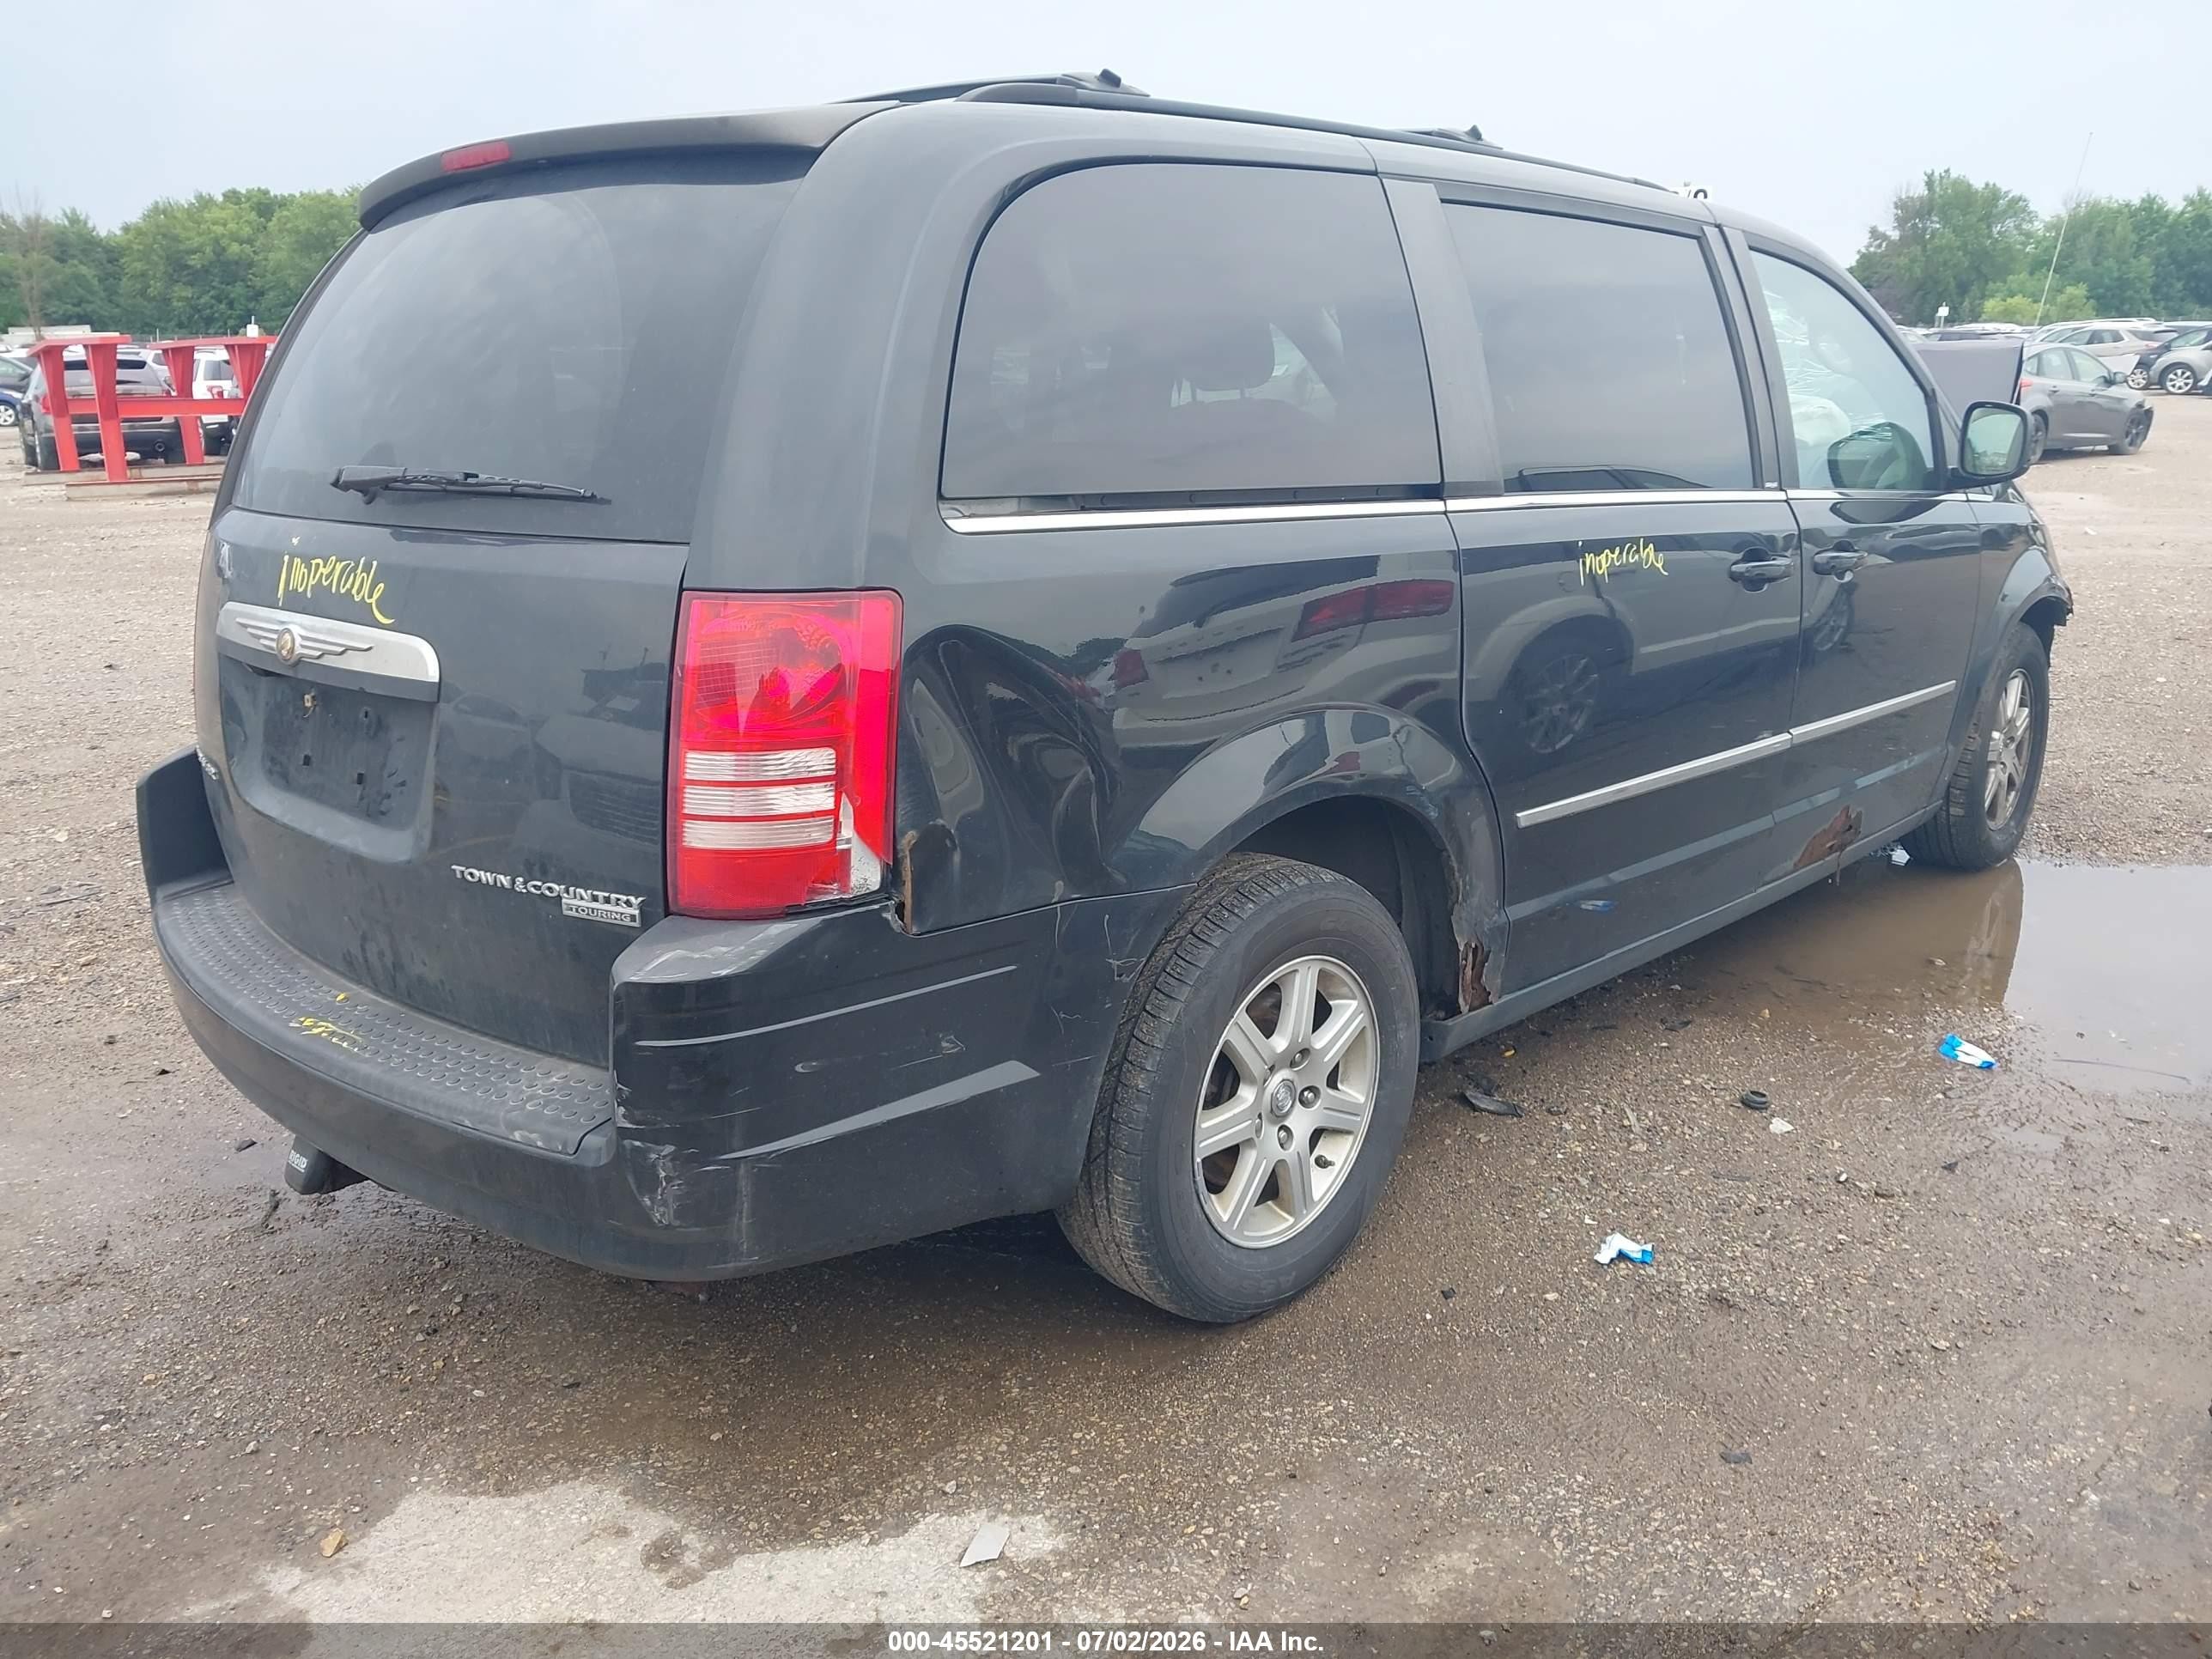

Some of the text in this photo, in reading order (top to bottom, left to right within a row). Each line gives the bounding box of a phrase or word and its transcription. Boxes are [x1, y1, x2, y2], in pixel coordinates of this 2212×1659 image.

[451, 864, 512, 890] TOWN
[526, 880, 646, 909] COUNTRY
[569, 904, 633, 923] TOURING
